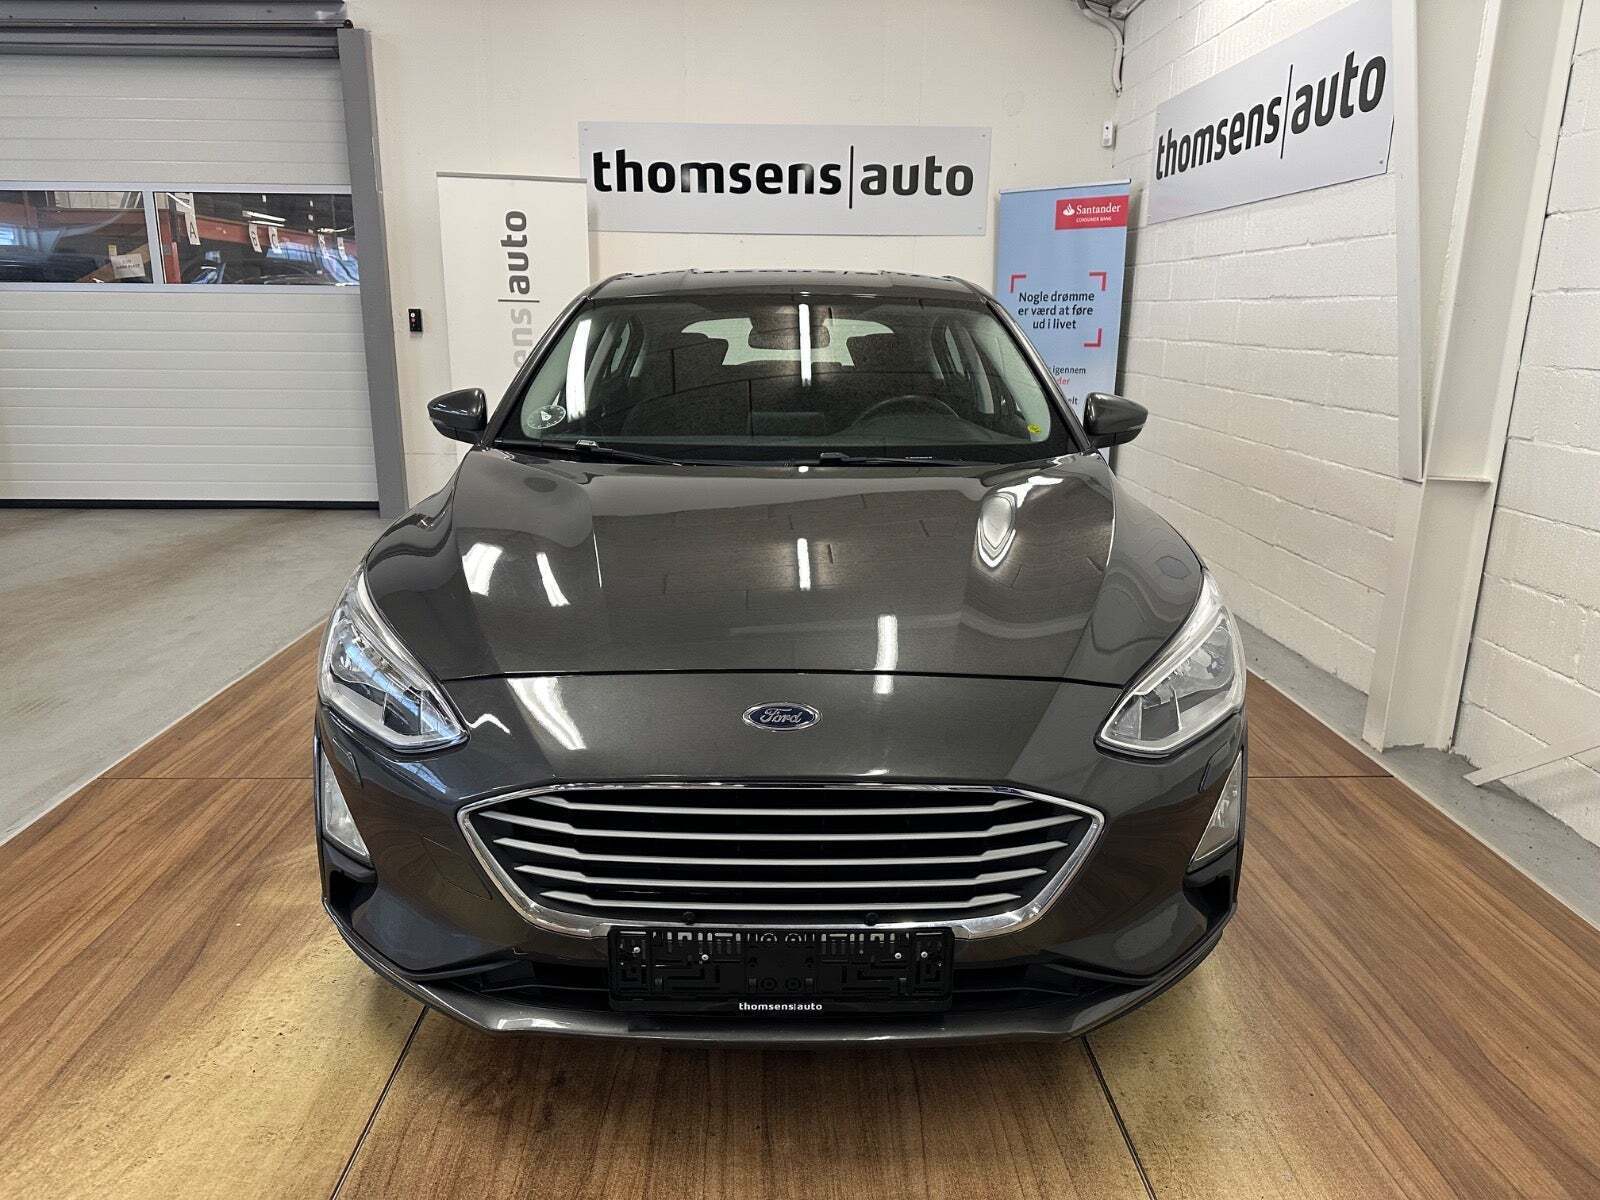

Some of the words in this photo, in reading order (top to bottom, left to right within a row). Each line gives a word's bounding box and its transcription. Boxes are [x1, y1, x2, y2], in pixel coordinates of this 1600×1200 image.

[1076, 202, 1121, 215] Santander
[1018, 291, 1049, 305] Nogle
[1051, 290, 1095, 302] drømme
[1018, 307, 1028, 316] er
[1031, 305, 1056, 316] værd
[1058, 306, 1070, 316] at
[1072, 304, 1094, 316] føre
[1033, 318, 1046, 329] ud
[1053, 318, 1077, 329] livet
[1052, 365, 1086, 376] igennem
[759, 707, 803, 723] Ford
